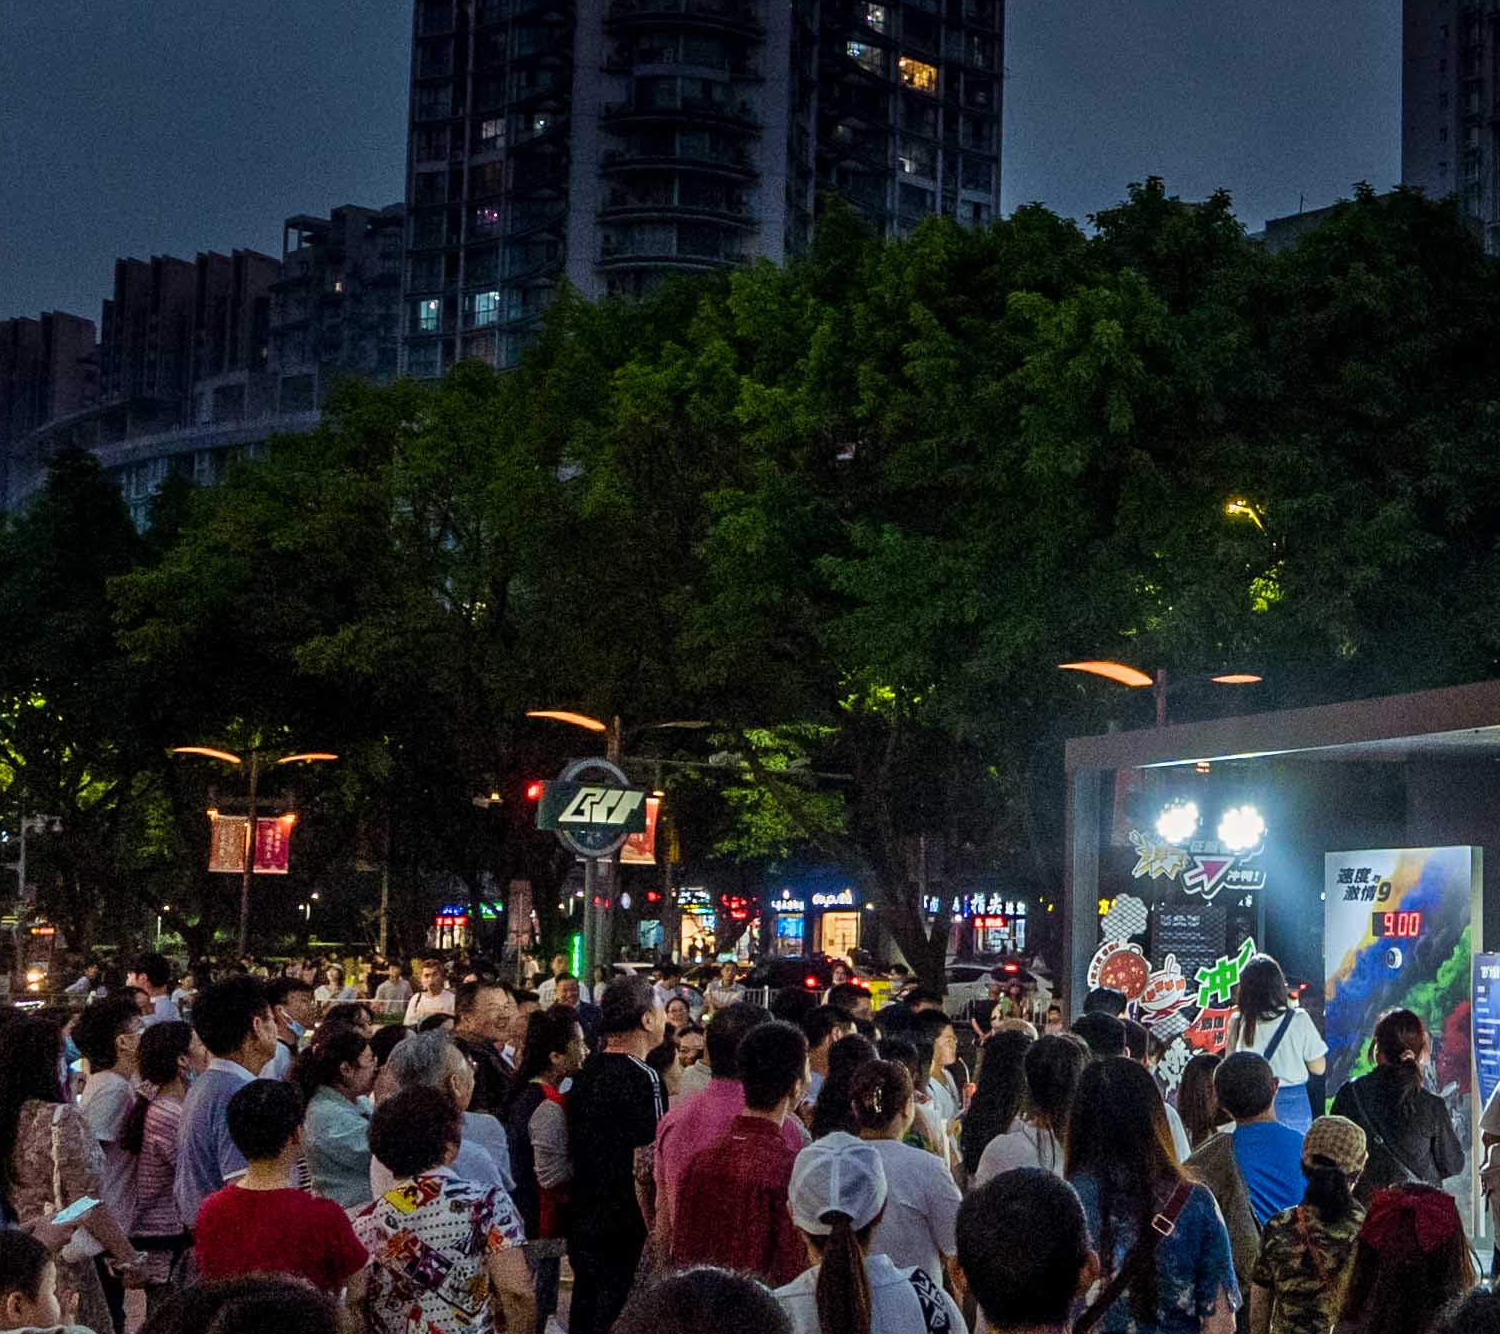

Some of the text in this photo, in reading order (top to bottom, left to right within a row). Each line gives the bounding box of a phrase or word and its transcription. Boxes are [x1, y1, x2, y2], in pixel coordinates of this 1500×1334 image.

[1337, 867, 1382, 885] 速度与
[1343, 881, 1392, 902] 激情9
